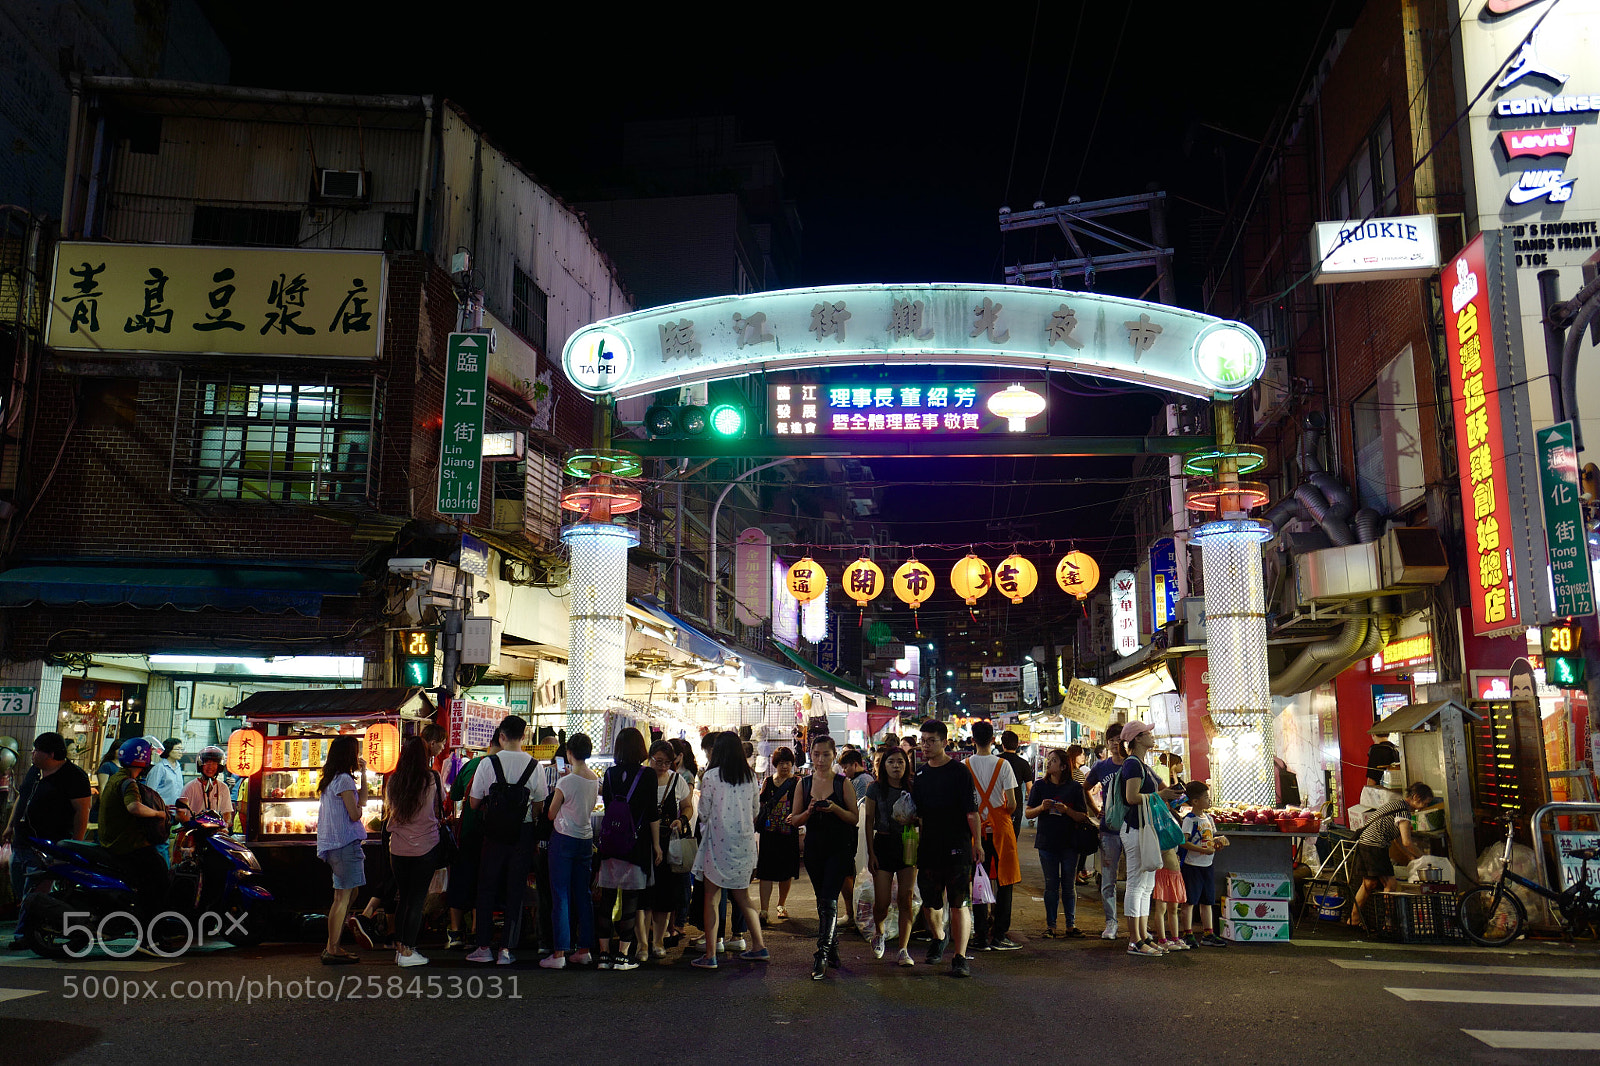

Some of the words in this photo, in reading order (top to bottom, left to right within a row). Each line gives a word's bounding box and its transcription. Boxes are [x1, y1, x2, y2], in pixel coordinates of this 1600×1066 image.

[1498, 95, 1600, 115] CONVERSE
[1519, 170, 1563, 188] NIKE
[1340, 222, 1418, 245] ROOKIE
[1540, 221, 1598, 236] FAVORITE
[1514, 238, 1555, 251] RANDS
[1558, 236, 1592, 249] FROM
[1525, 253, 1548, 266] TOE
[61, 262, 372, 335] 青島豆漿店
[658, 297, 1164, 363] 臨江街觀光夜市
[453, 352, 479, 443] 臨江街
[444, 445, 463, 455] Lin
[443, 457, 475, 468] Jiang
[443, 469, 458, 480] St.
[466, 481, 473, 491] 4
[1547, 445, 1576, 543] 通化街
[440, 499, 457, 509] 103
[460, 499, 478, 509] 116
[1550, 545, 1578, 558] Tong
[1552, 559, 1574, 571] Hua
[792, 569, 813, 594] 四通
[850, 568, 877, 595] 開
[902, 568, 930, 595] 市
[997, 564, 1020, 592] 吉
[1061, 561, 1084, 587] 八達
[1553, 573, 1569, 585] St.
[1554, 585, 1571, 597] 163
[1559, 604, 1571, 616] 77
[1578, 601, 1591, 613] 72
[1550, 627, 1571, 652] 20
[2, 697, 23, 712] 73
[124, 711, 142, 724] 71
